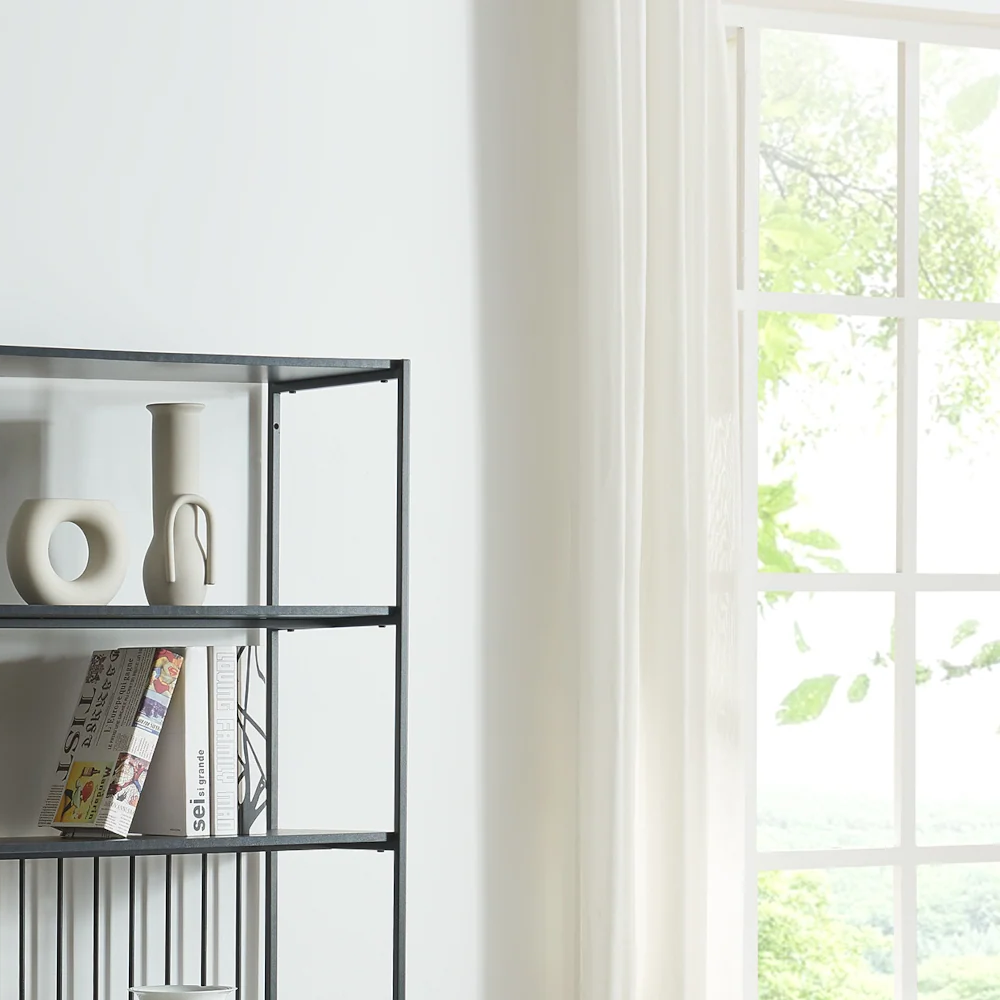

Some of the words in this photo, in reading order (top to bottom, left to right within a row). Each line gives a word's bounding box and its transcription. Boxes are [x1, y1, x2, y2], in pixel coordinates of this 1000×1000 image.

[216, 652, 235, 711] LOVING
[197, 749, 206, 785] grande
[216, 718, 235, 784] FAMILY
[190, 799, 206, 832] sei
[216, 791, 235, 831] MAN
